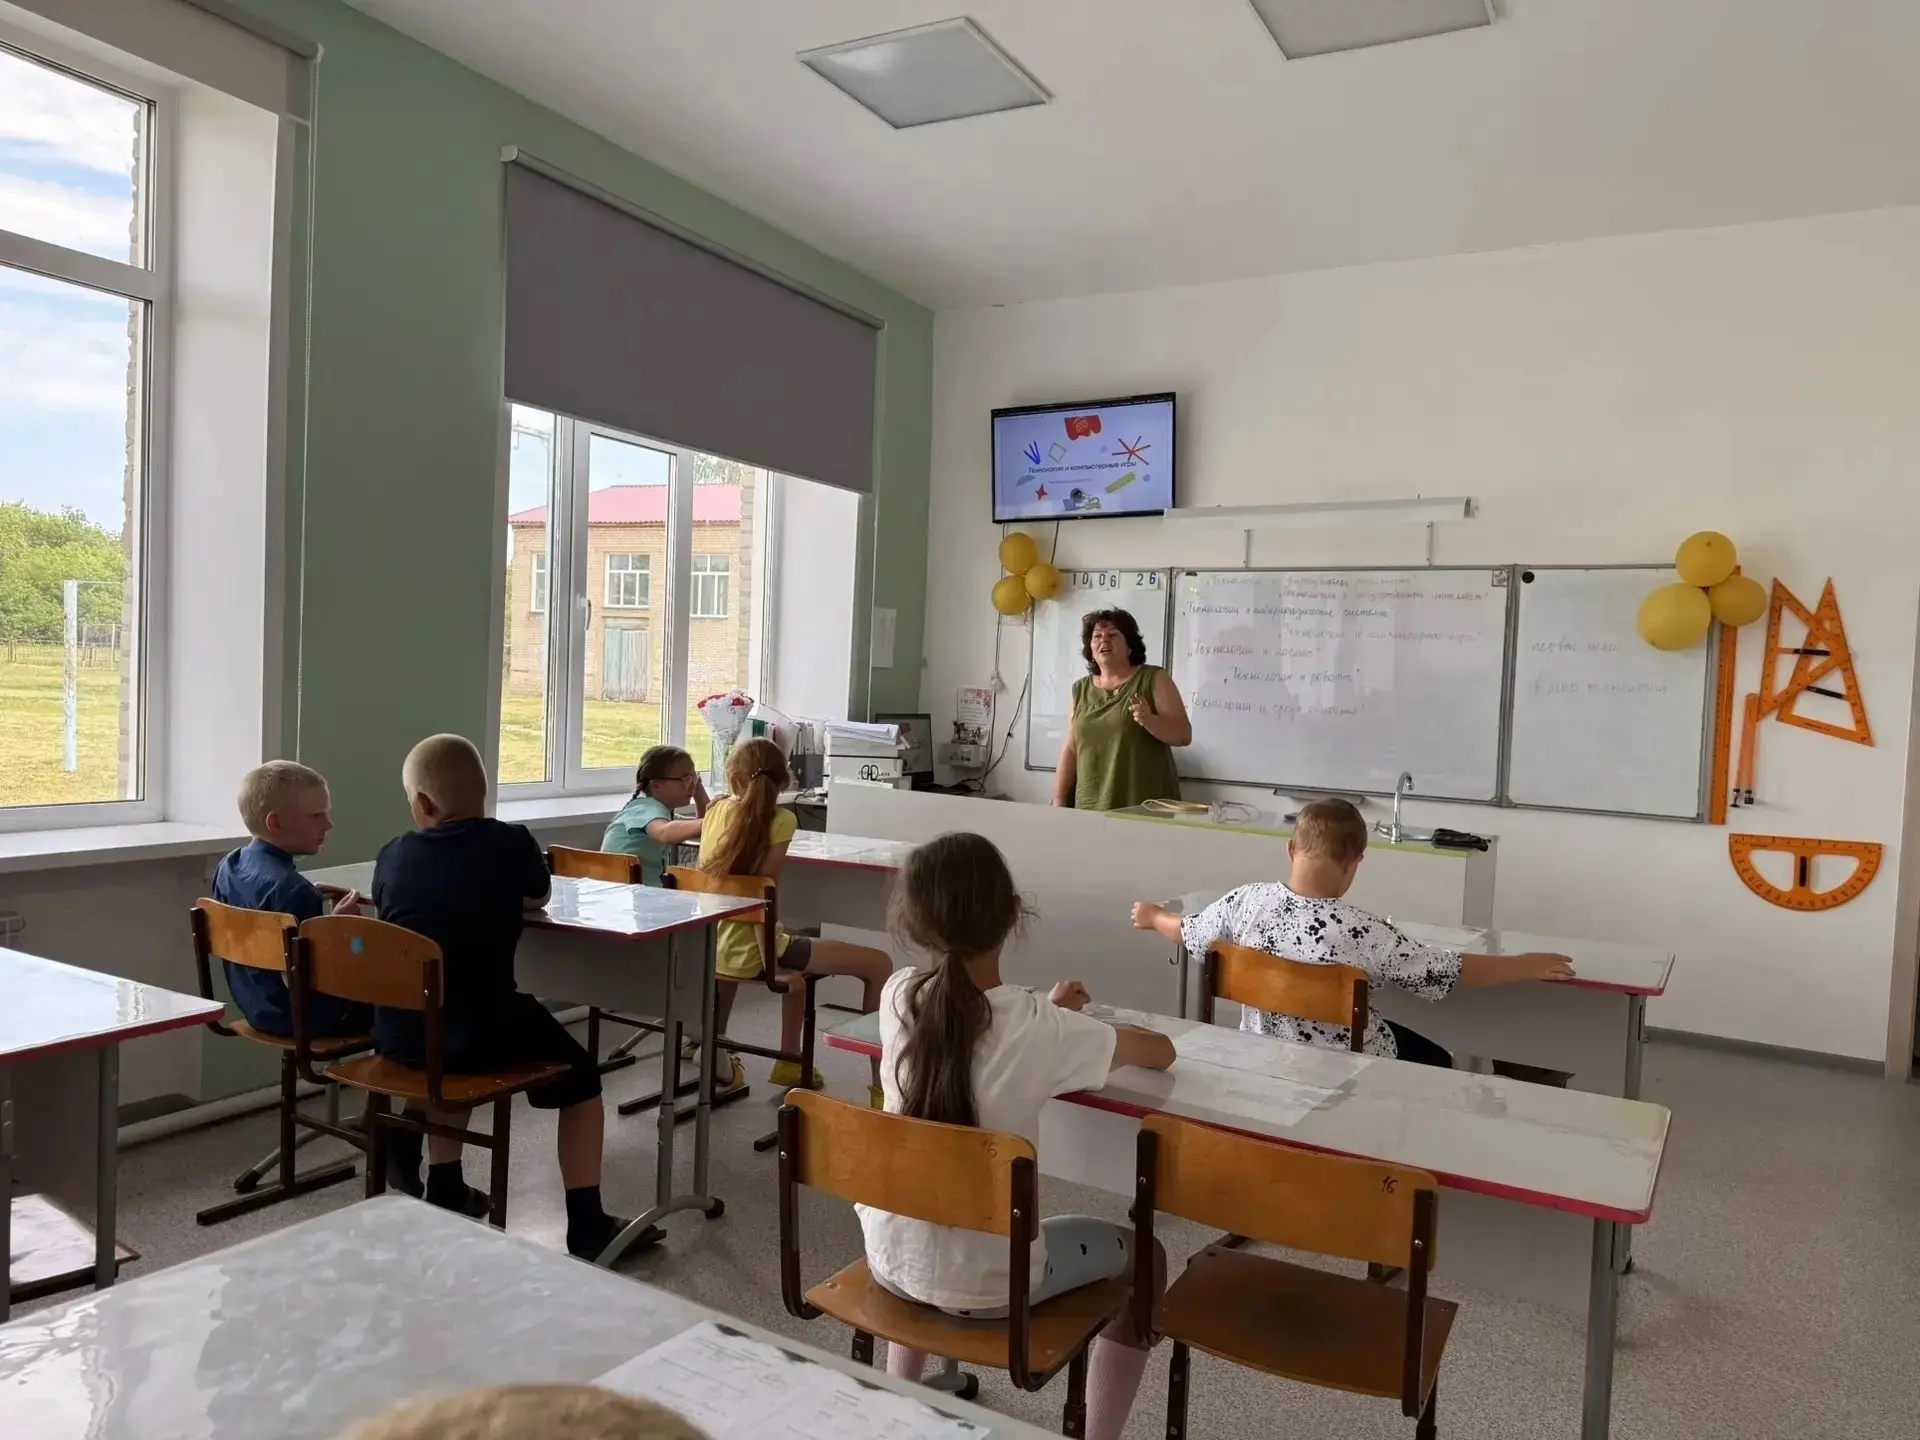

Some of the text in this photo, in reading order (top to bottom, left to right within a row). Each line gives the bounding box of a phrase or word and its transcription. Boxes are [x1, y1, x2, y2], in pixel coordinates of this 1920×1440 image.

[1028, 466, 1064, 474] Технологии
[1070, 463, 1120, 472] компьютерные
[1120, 460, 1137, 468] игры
[1099, 574, 1117, 588] 06
[1136, 572, 1157, 586] 26
[1382, 1176, 1398, 1194] 16
